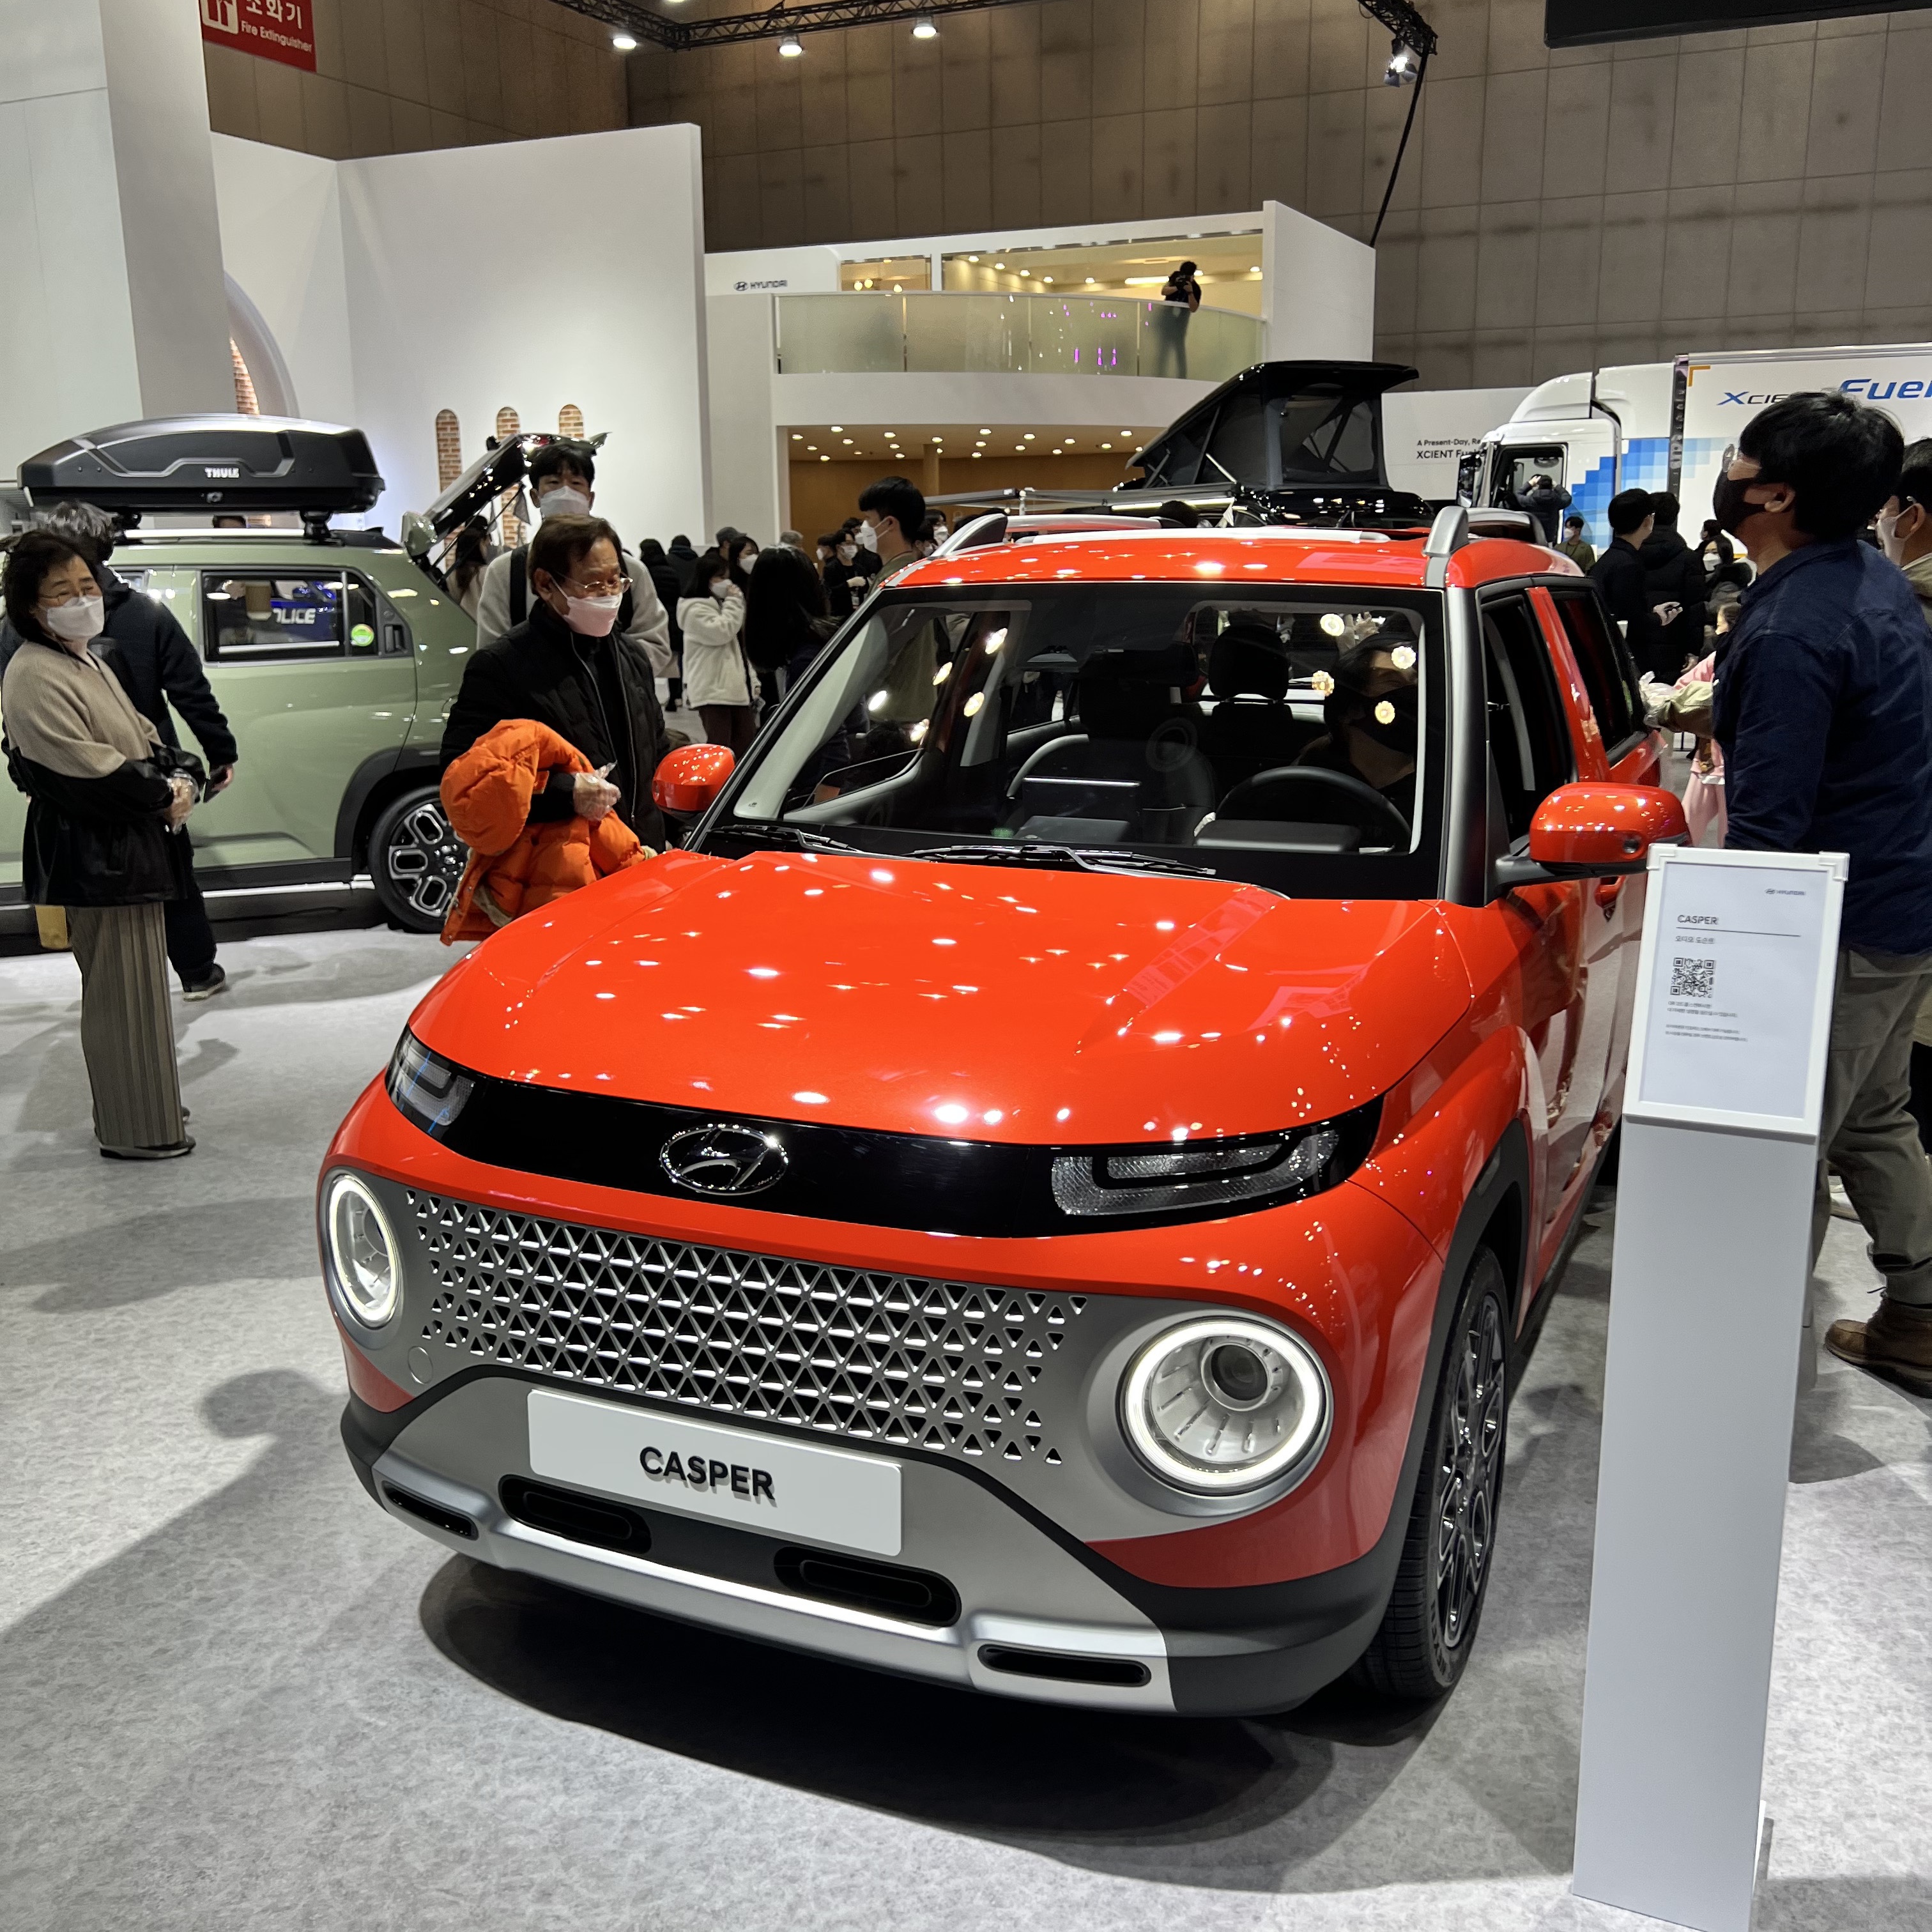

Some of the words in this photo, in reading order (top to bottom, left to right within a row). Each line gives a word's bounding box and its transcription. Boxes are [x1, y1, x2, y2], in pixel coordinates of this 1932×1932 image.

[241, 20, 258, 36] Fire
[260, 26, 312, 52] Extinguisher
[749, 280, 788, 289] HYUNDAI
[1716, 391, 1790, 405] XCIE
[1416, 449, 1454, 459] XCIENT
[205, 467, 240, 478] THULE
[273, 608, 316, 625] OLICE
[1677, 914, 1719, 925] CASPER
[640, 1446, 776, 1501] CASPER
